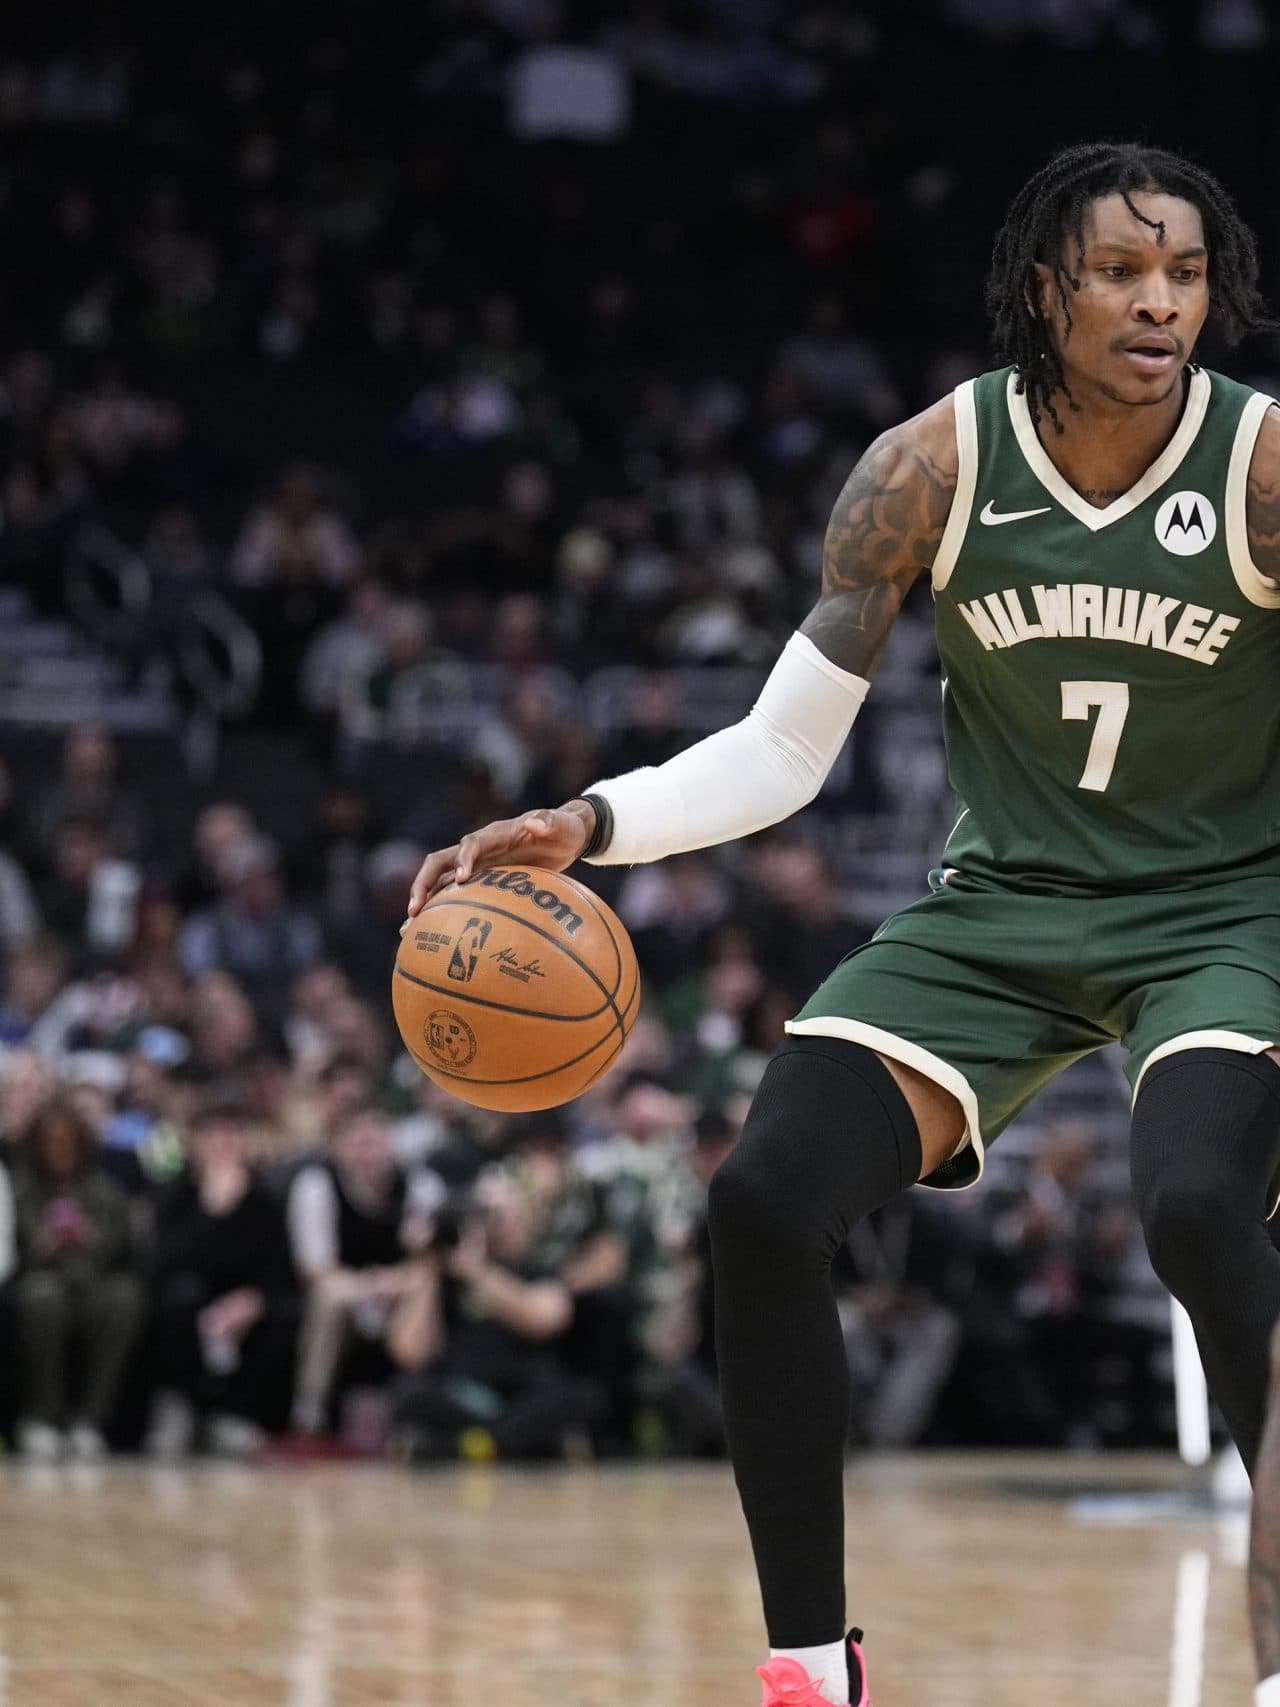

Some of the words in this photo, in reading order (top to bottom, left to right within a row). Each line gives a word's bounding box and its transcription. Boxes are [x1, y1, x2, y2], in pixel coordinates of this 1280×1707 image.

[957, 583, 1242, 666] MILWAUKEE
[1060, 680, 1130, 792] 7
[459, 870, 584, 939] ilson
